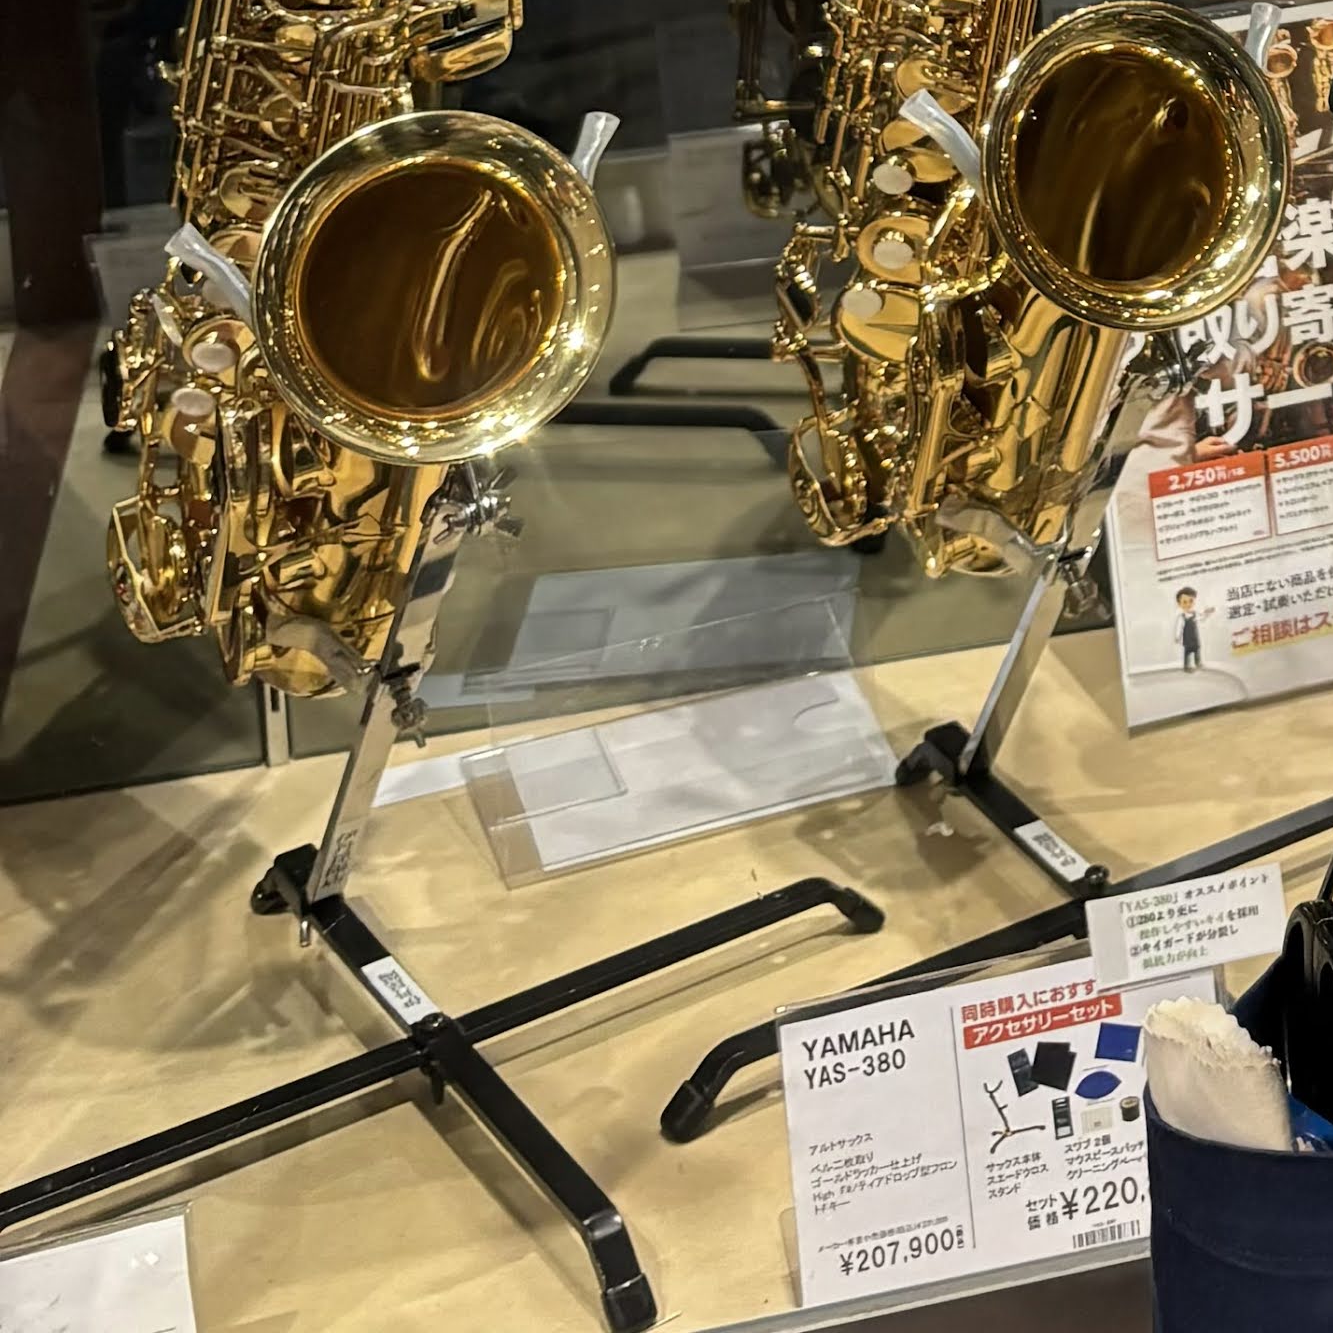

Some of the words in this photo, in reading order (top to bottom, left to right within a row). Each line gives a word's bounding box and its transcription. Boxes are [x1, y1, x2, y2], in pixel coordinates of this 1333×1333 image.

[801, 1018, 916, 1062] YAMAHA
[972, 999, 1114, 1046] アクセサリーセット
[803, 1048, 907, 1090] YAS-380
[808, 1133, 874, 1156] アルトサックス
[1025, 1193, 1058, 1213] セット
[839, 1228, 954, 1276] ¥207,900
